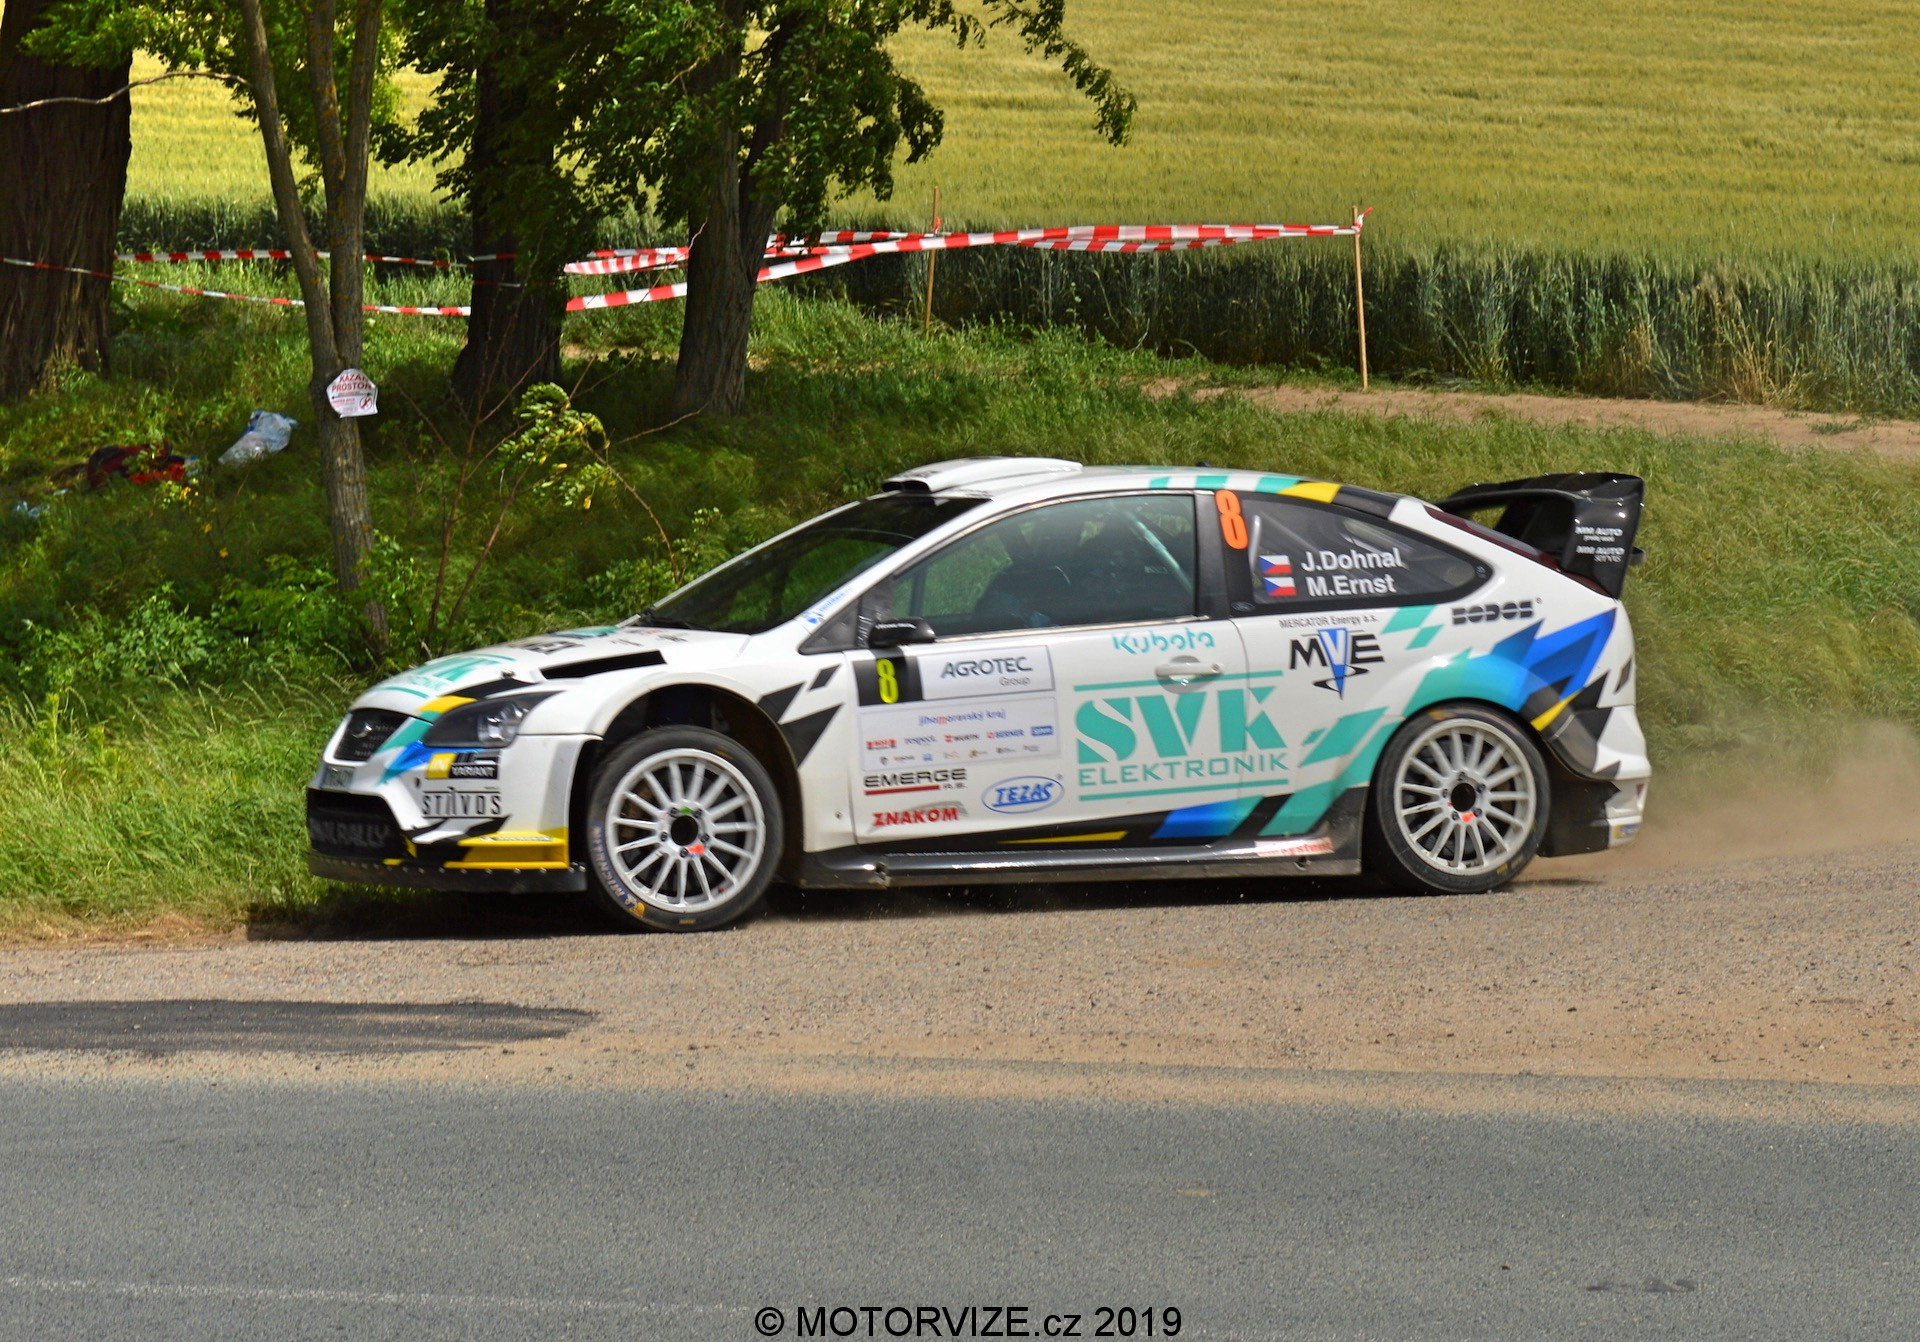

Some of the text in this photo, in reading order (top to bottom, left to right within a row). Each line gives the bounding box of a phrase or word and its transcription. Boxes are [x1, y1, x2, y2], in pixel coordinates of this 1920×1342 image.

[1214, 489, 1249, 549] 8
[1301, 547, 1403, 572] J.Dohnal
[1305, 573, 1397, 597] M.Ernst
[1279, 616, 1329, 628] MERCATOR
[1330, 614, 1361, 626] Energy
[1112, 626, 1216, 654] Kubota
[941, 656, 1033, 679] AGROTEC
[875, 657, 900, 704] 8
[999, 676, 1031, 687] Group
[1074, 686, 1288, 764] SVK
[451, 765, 496, 777] VARIANT
[863, 768, 967, 788] EMERGE
[1078, 753, 1289, 787] ELEKTRONIK
[994, 781, 1054, 805] TEZAS
[872, 807, 959, 827] ZNAKOM
